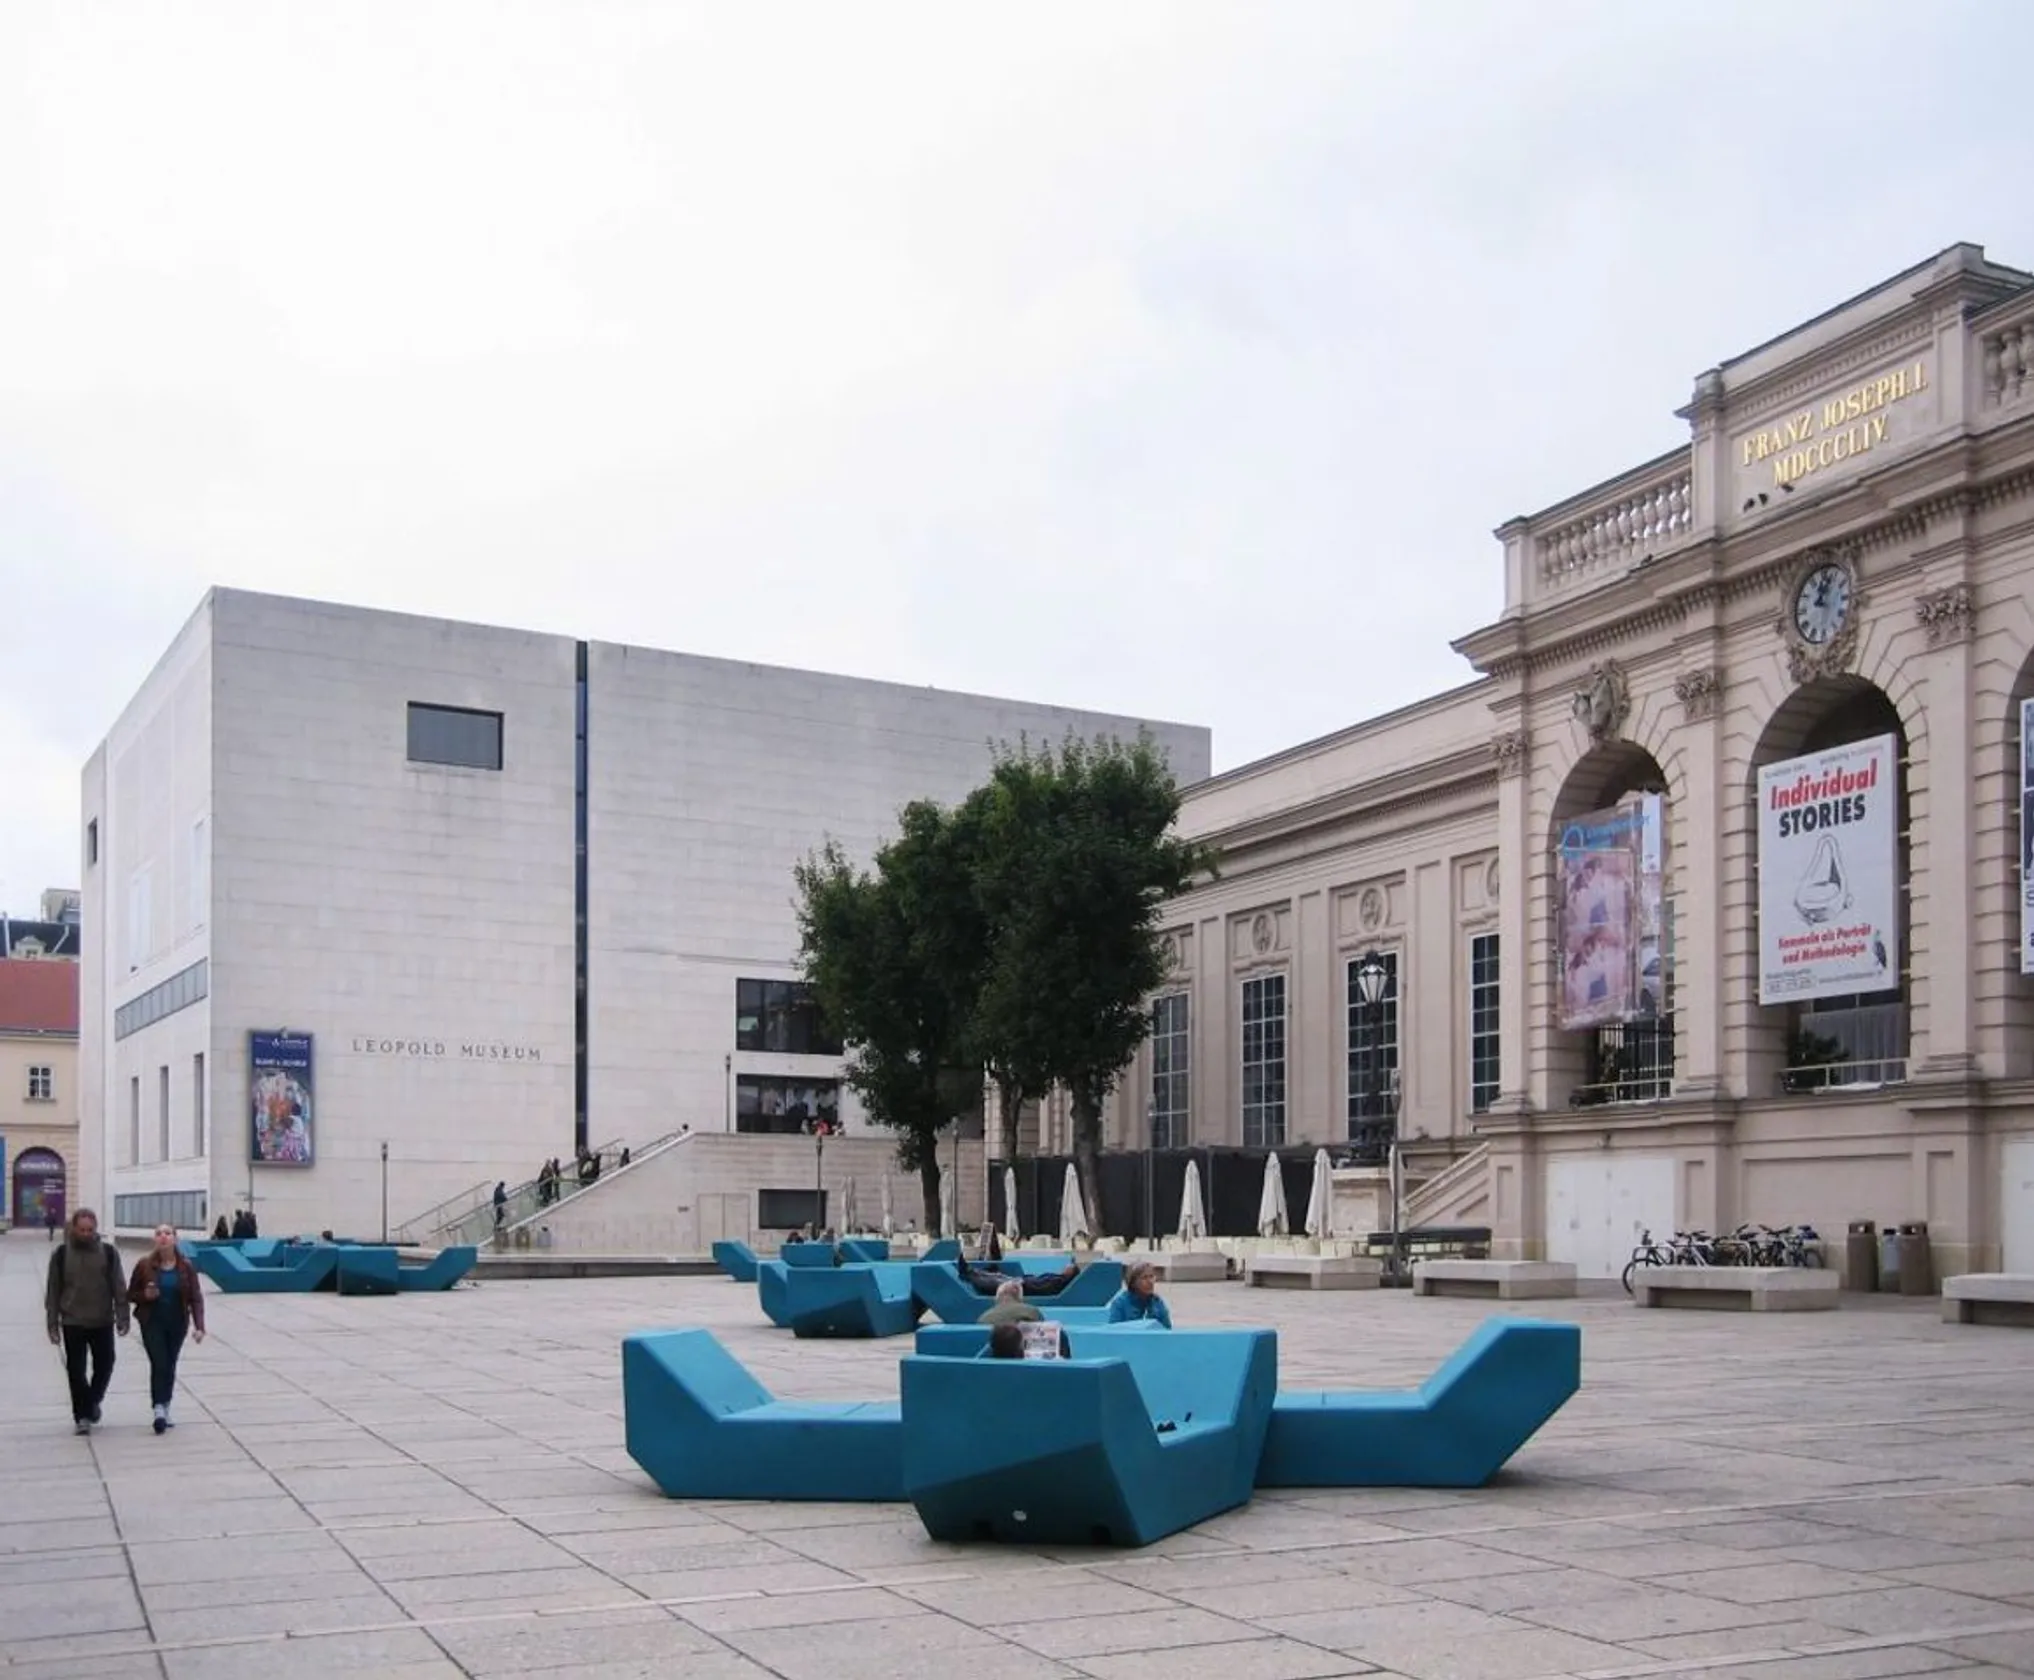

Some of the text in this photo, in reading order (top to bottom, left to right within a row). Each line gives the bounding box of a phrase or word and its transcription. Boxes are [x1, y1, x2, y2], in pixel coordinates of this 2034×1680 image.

[1743, 410, 1813, 466] FRANZ
[1771, 758, 1878, 810] Individual
[1779, 793, 1866, 838] STORIES
[352, 1039, 541, 1061] LEOPOLD MUSEUM
